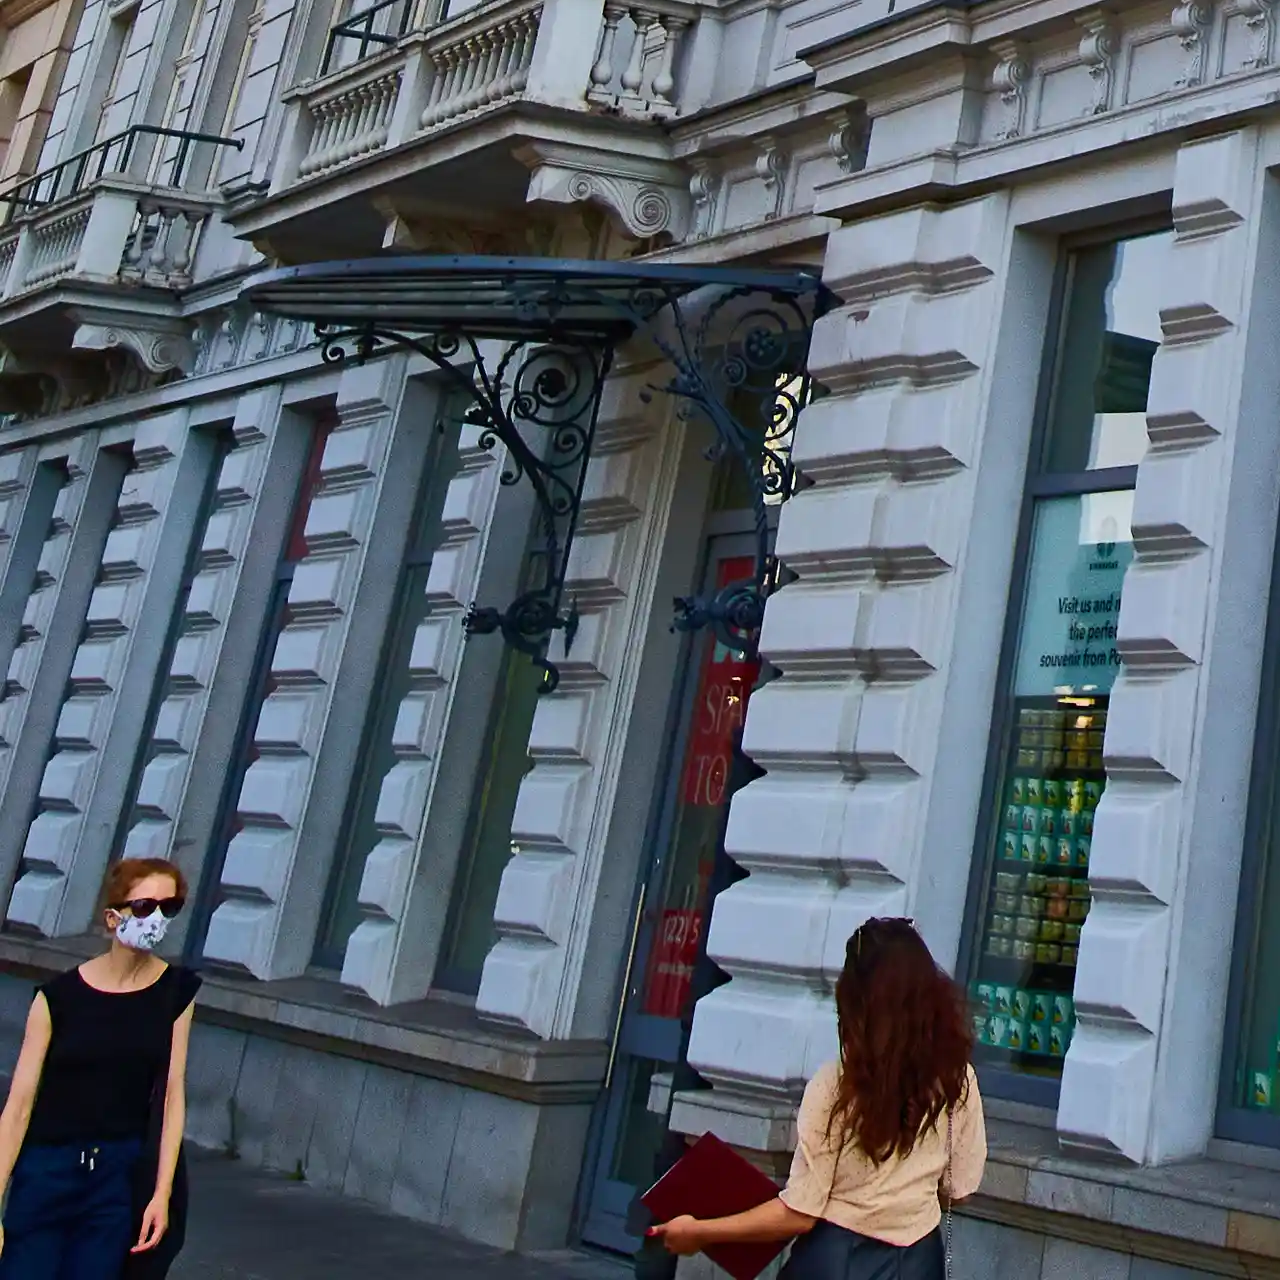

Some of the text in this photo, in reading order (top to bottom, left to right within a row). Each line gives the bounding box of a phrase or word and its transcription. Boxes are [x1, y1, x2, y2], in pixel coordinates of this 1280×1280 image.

[1058, 596, 1079, 614] Visit
[1080, 599, 1092, 613] us
[1093, 594, 1114, 613] and
[1069, 621, 1087, 640] the
[1039, 648, 1081, 668] souvenir
[1082, 648, 1106, 667] from
